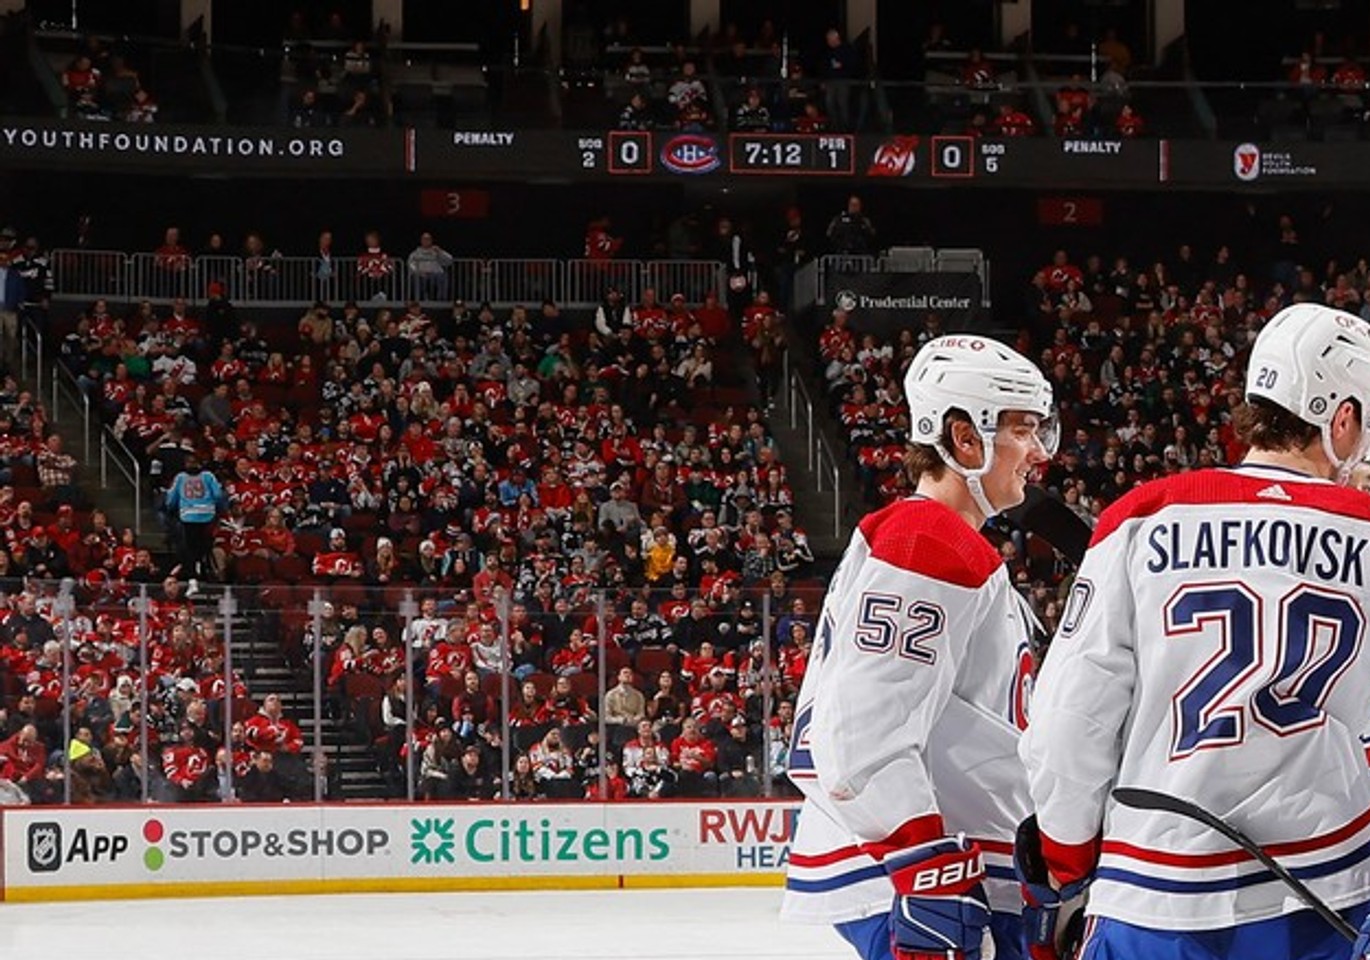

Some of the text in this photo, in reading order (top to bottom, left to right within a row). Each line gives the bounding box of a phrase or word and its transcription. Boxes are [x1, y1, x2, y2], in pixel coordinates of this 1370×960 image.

[2, 127, 344, 157] YOUTHFOUNDATION.ORG
[453, 131, 514, 146] PENALTY
[819, 138, 846, 150] PER
[1063, 140, 1122, 154] PENALTY
[582, 152, 595, 168] 2
[620, 140, 638, 164] 0
[745, 142, 802, 166] 7:12
[828, 152, 838, 168] 1
[942, 144, 961, 168] 0
[985, 157, 998, 173] 5
[446, 192, 460, 214] 3
[1062, 203, 1077, 223] 2
[859, 294, 927, 310] Prudential
[928, 294, 971, 310] Center
[1256, 366, 1279, 390] 20
[854, 589, 946, 666] 52
[1163, 580, 1367, 762] 20
[169, 829, 390, 859] STOP&SHOP
[465, 818, 671, 864] Citizens
